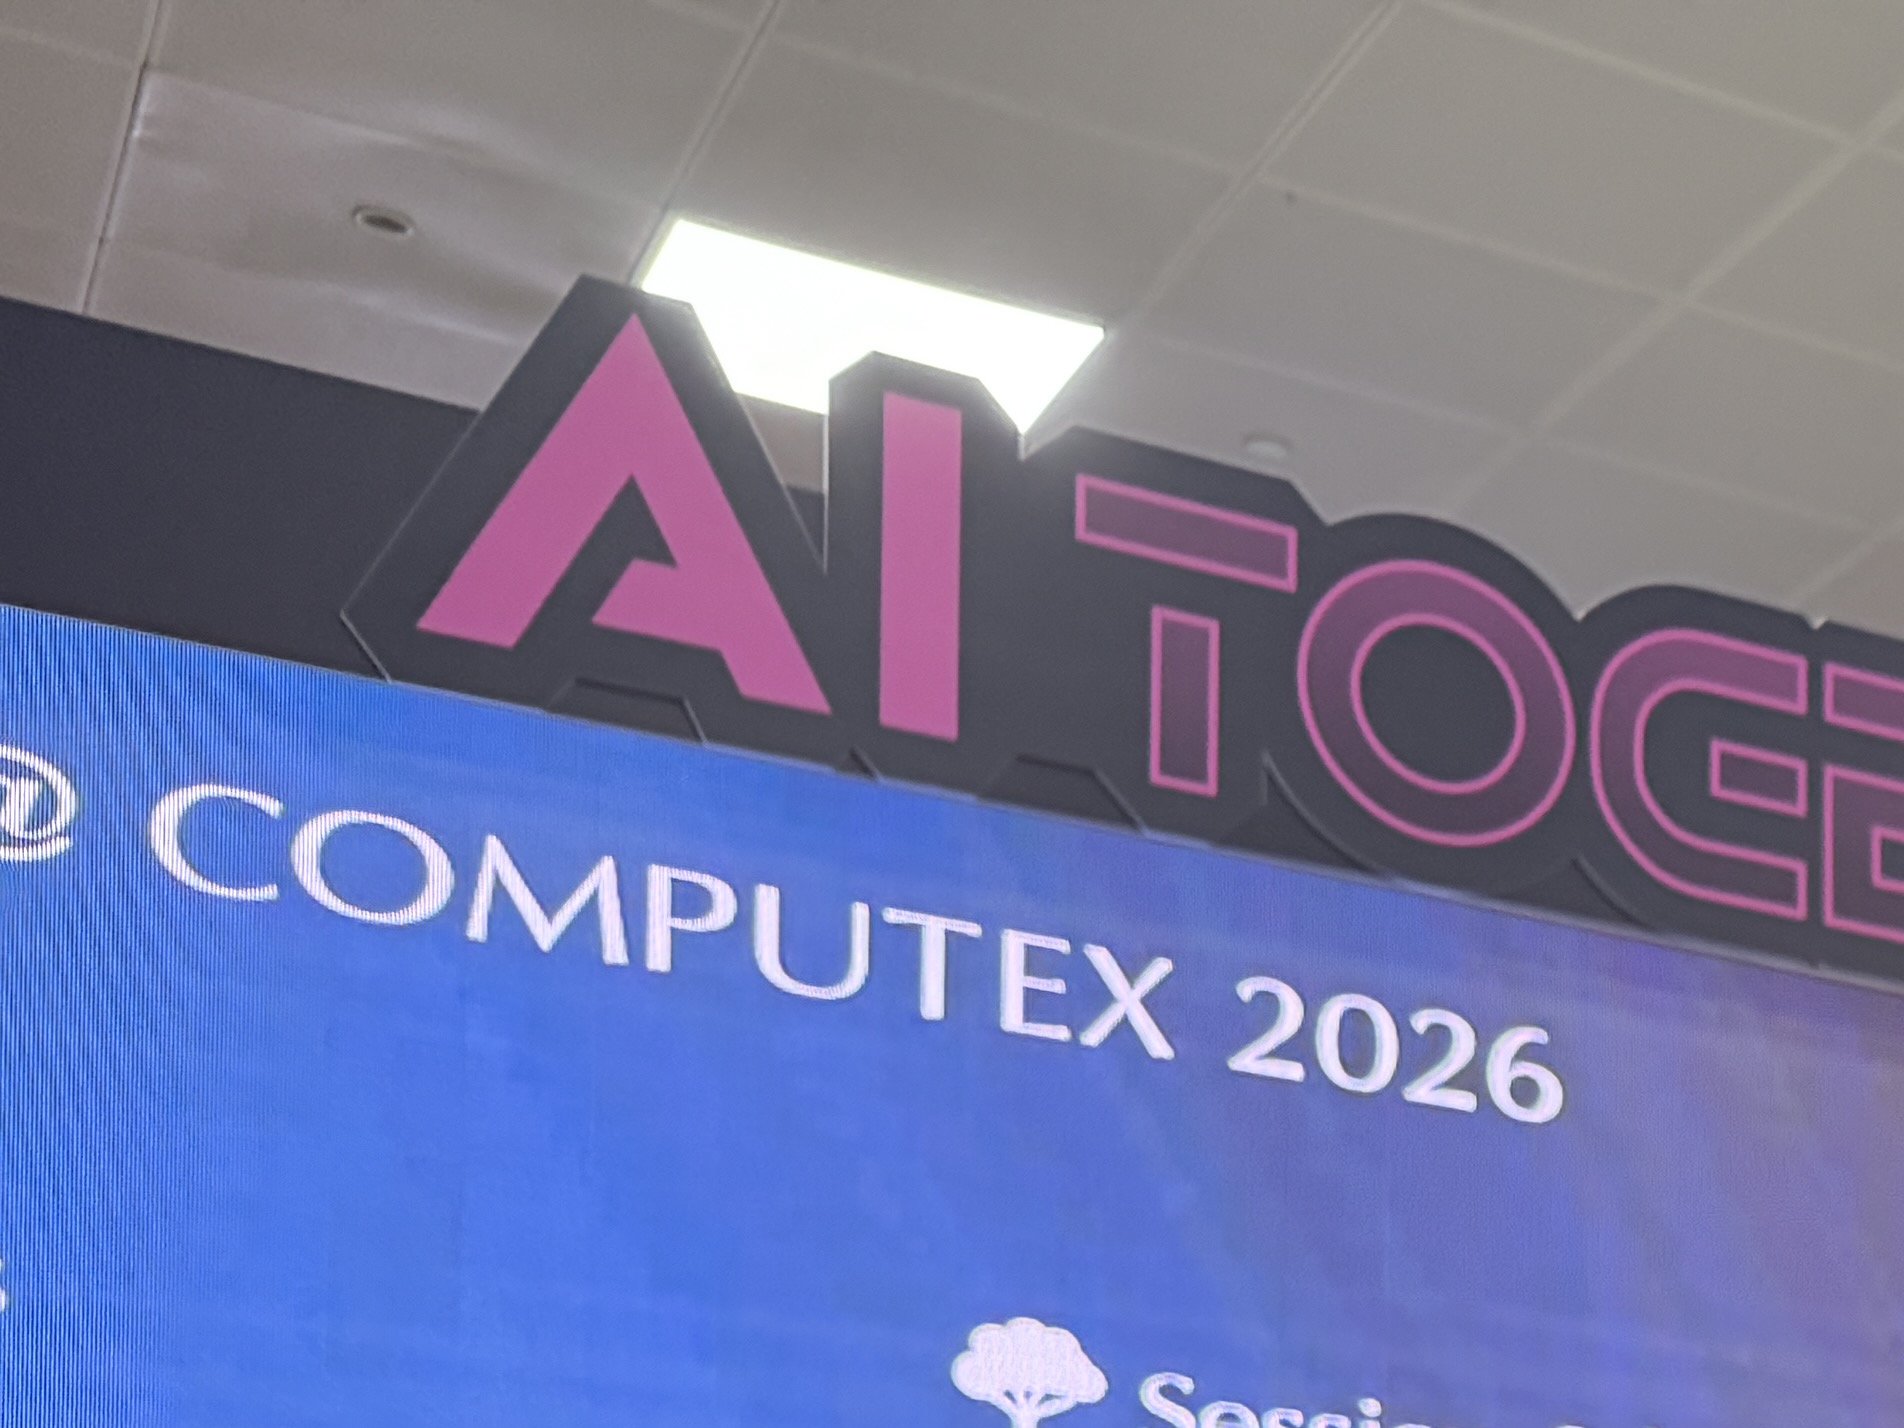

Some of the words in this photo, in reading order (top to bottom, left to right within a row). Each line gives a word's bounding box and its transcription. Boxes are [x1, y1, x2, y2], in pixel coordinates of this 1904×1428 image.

[416, 312, 962, 741] AI
[148, 784, 1174, 1060] COMPUTEX
[1228, 975, 1564, 1125] 2026
